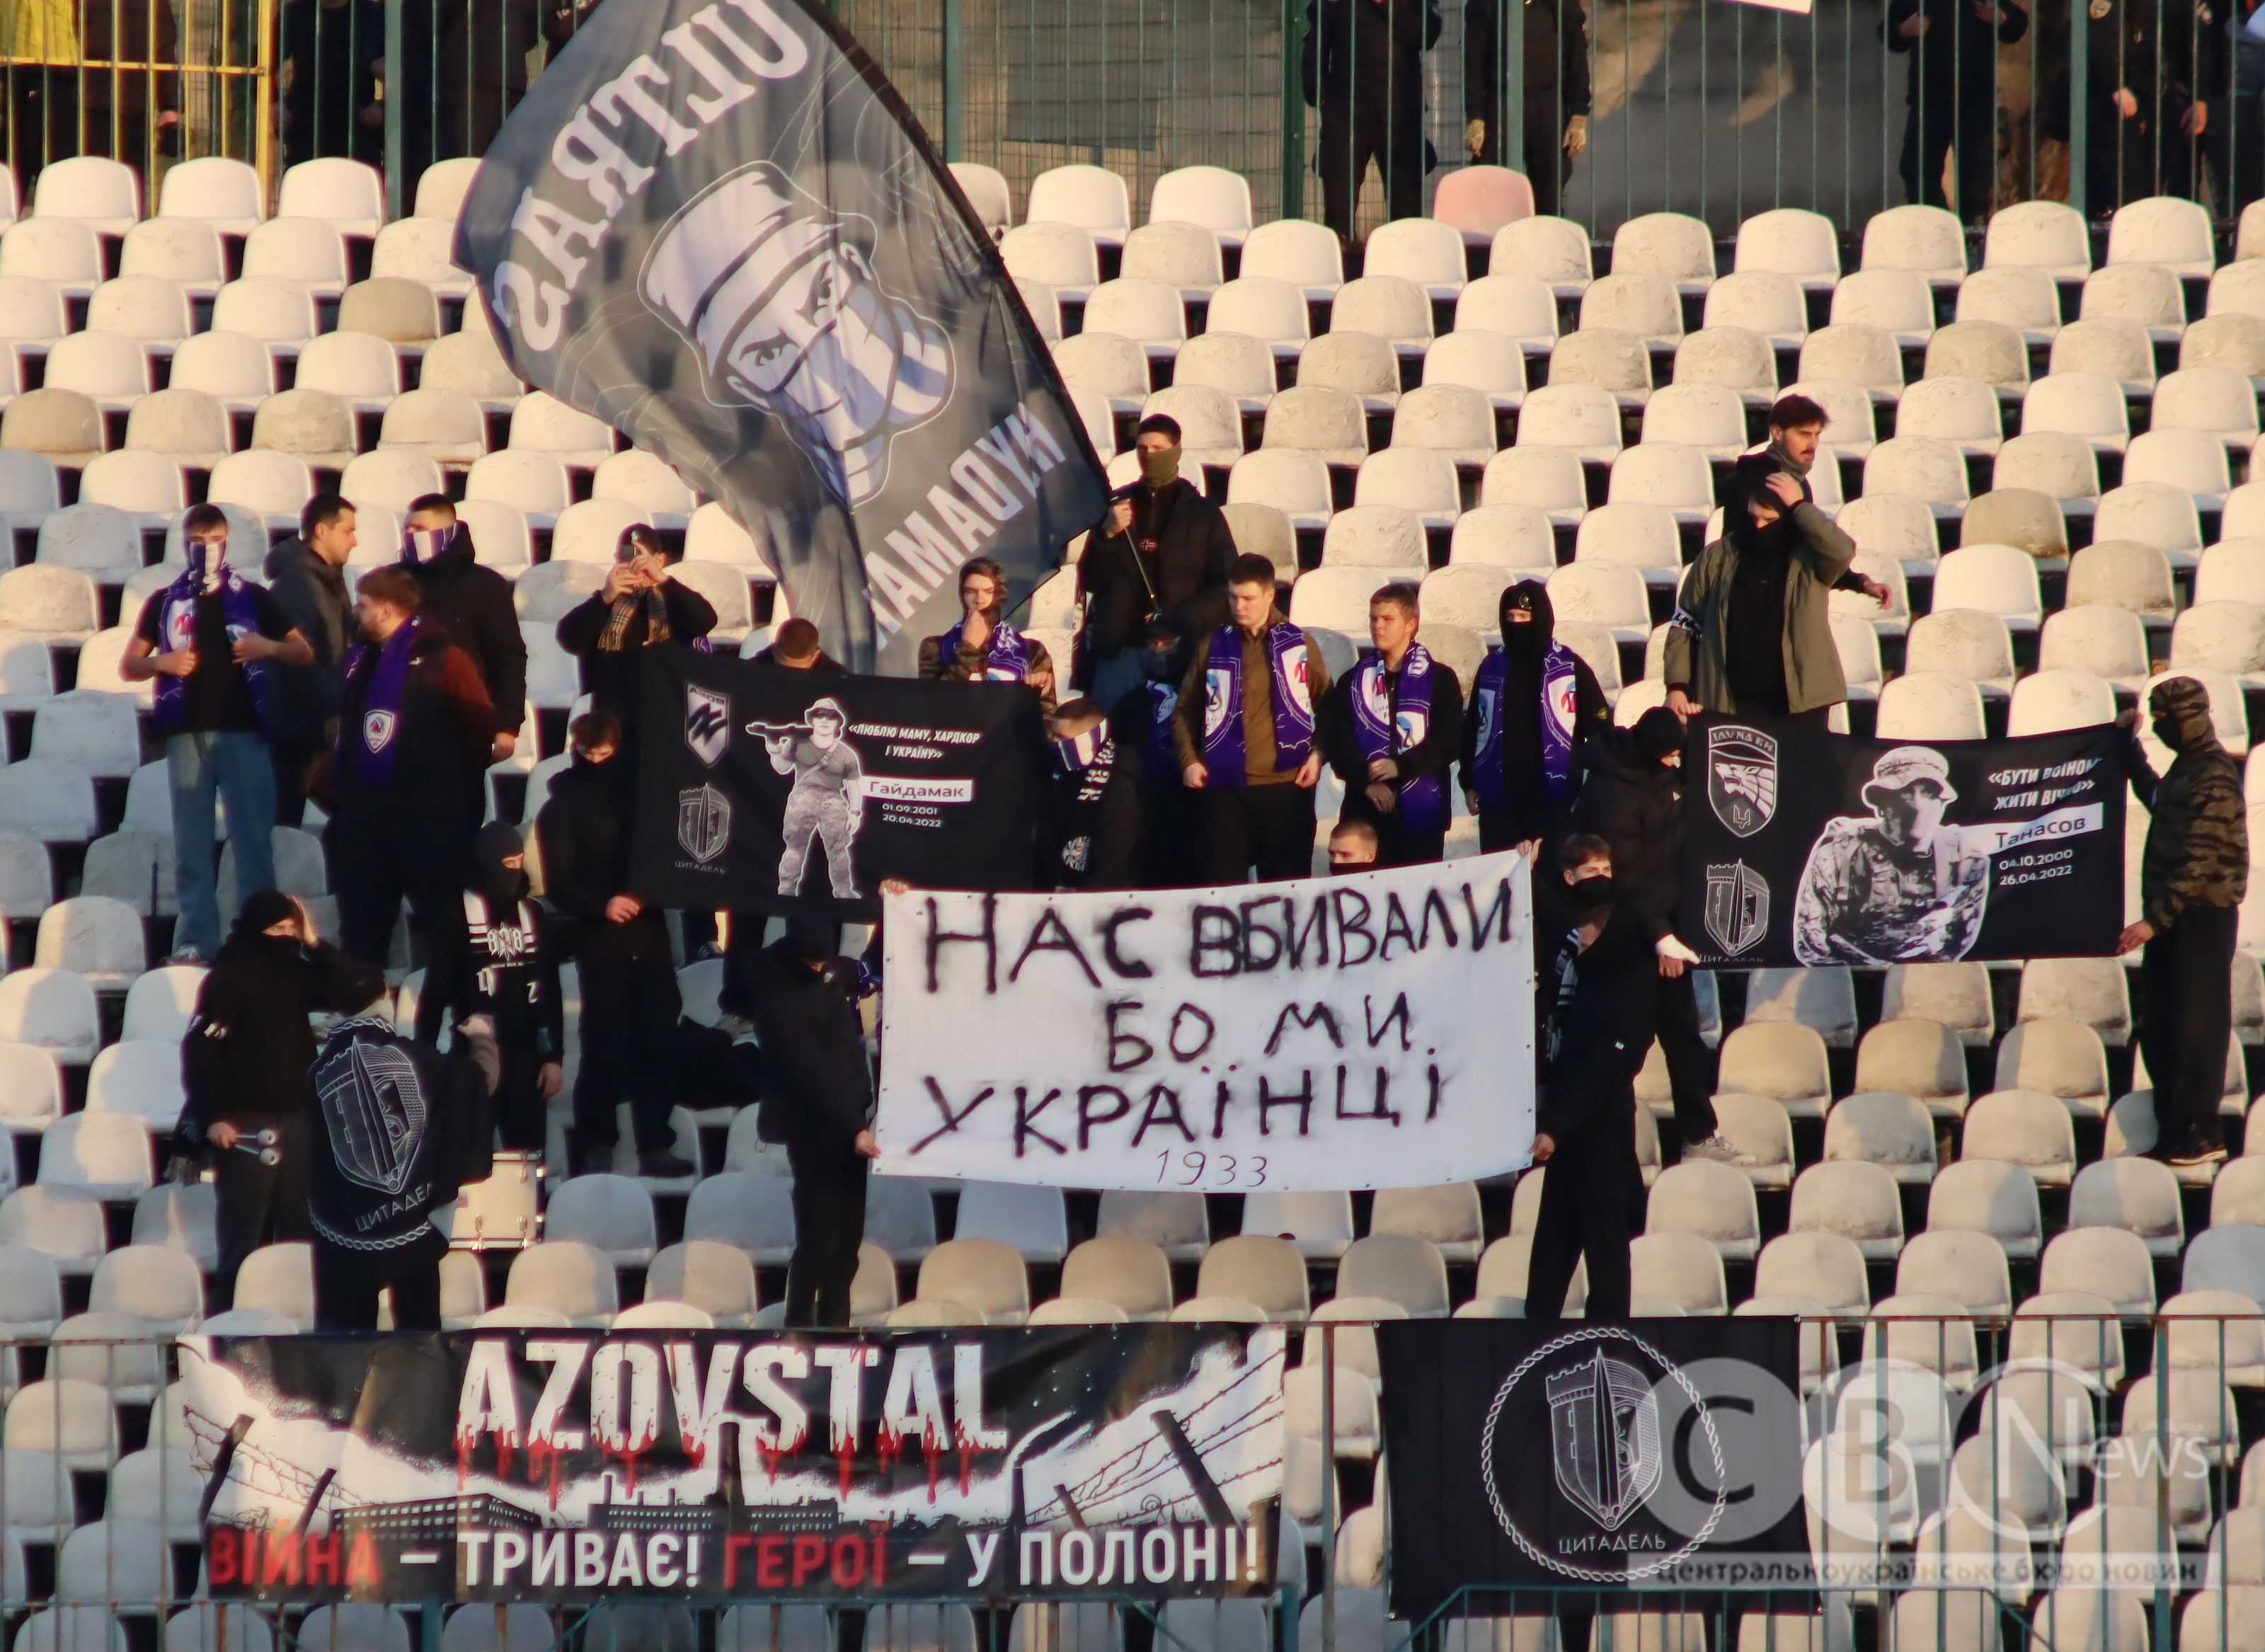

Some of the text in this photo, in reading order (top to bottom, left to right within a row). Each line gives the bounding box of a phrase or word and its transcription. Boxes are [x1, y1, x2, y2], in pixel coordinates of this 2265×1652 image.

[848, 723, 981, 744] «ЛЮБЛЮ МАМУ, ХАРДКОР
[892, 745, 944, 759] УКРАЇНУ»
[1988, 768, 2040, 786] «БУТИ
[869, 781, 965, 799] Гайдамак
[1993, 791, 2039, 810] ЖИТИ
[882, 803, 938, 815] 01.09.2001
[883, 813, 942, 827] 20.04.2022
[1995, 818, 2086, 849] Танасов
[1999, 849, 2074, 871] 04.10.2000
[1999, 864, 2073, 886] 26.04.2022
[924, 878, 1513, 994] НАС ВБИВАЛИ
[1106, 992, 1413, 1072] БО МИ
[908, 1047, 1448, 1158] УКРАЇНЦІ
[1154, 1149, 1269, 1188] 1933
[455, 1338, 1008, 1458] AZOVSTAL
[209, 1518, 381, 1588] ВІЙНА
[458, 1531, 701, 1588] ТРИВАЄ!
[723, 1520, 890, 1589] ГЕРОЇ
[1019, 1526, 1259, 1586] ПОЛОНІ!
[1559, 1534, 1666, 1556] ЦИТАДЕЛЬ
